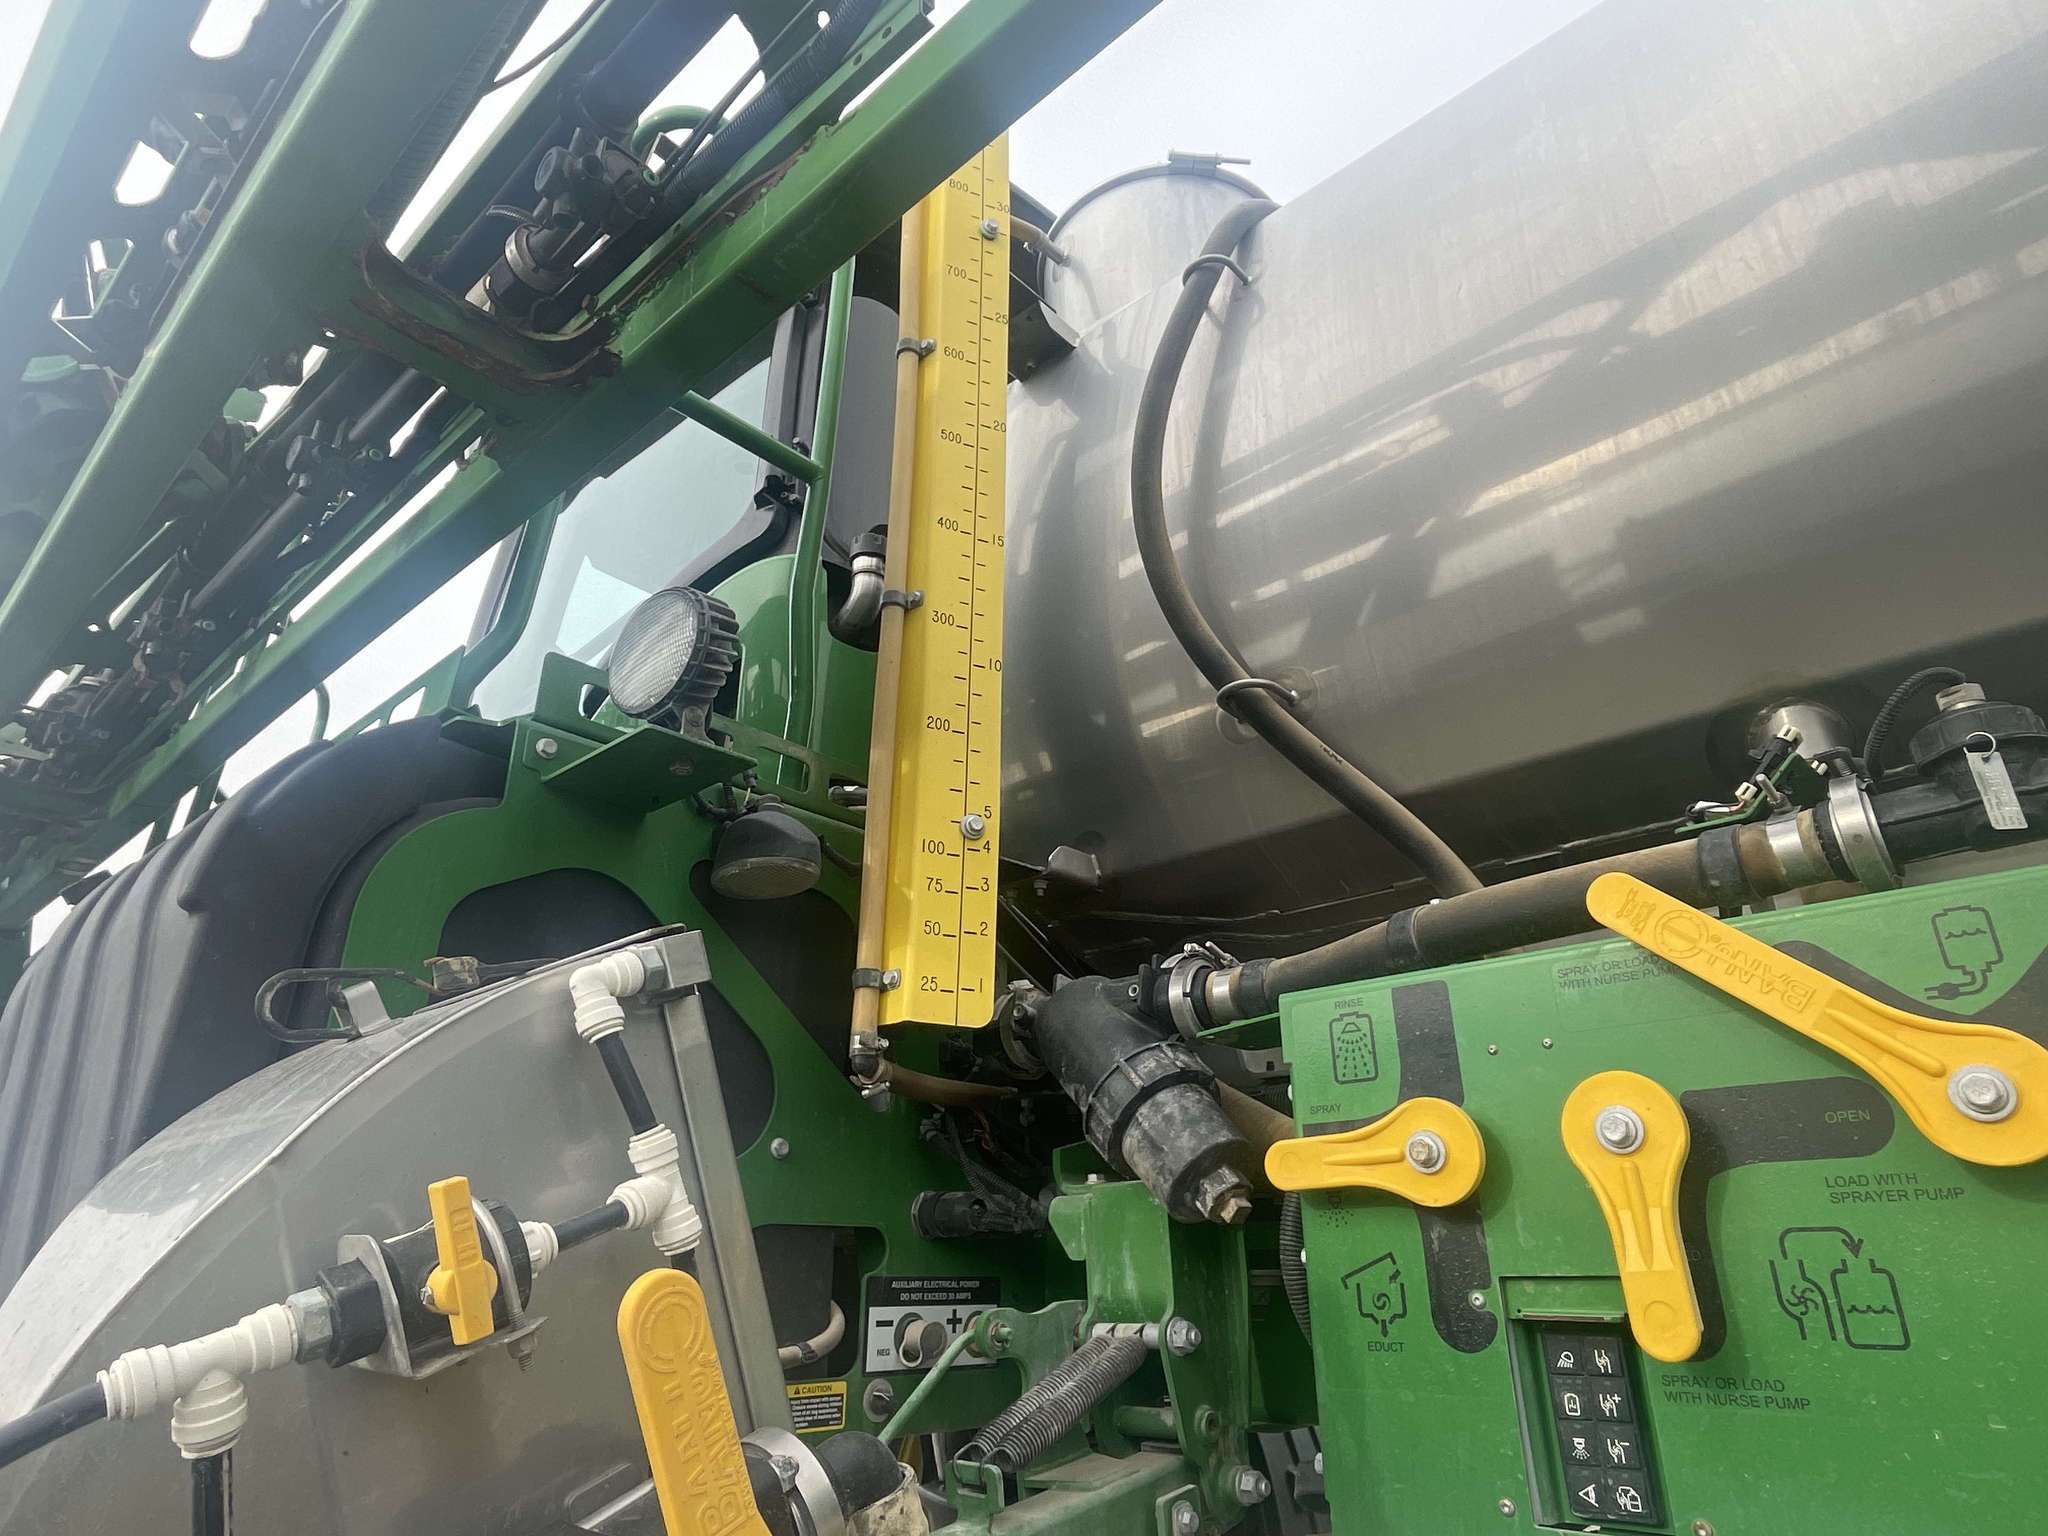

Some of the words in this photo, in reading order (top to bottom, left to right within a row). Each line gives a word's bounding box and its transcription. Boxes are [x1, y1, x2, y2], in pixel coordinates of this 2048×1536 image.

[948, 178, 969, 193] 800
[996, 201, 1010, 214] 30
[946, 263, 967, 279] 700
[995, 312, 1008, 325] 25
[943, 345, 965, 361] 600
[993, 420, 1007, 433] 20
[940, 428, 962, 444] 500
[936, 516, 959, 532] 400
[992, 533, 1005, 547] 15
[932, 610, 955, 627] 300
[989, 657, 1002, 672] 10
[926, 715, 950, 732] 200
[983, 805, 992, 819] 5
[921, 838, 945, 855] 100
[983, 840, 991, 854] 4
[926, 876, 943, 893] 75
[981, 877, 990, 892] 3
[923, 920, 941, 936] 50
[979, 921, 989, 937] 2
[1557, 964, 1598, 979] SPRAY
[1602, 960, 1621, 972] OR
[1624, 954, 1660, 969] LOAD
[920, 975, 938, 992] 25
[1560, 978, 1592, 991] WITH
[1595, 970, 1640, 986] NURSE
[1334, 997, 1364, 1010] RINSE
[1309, 1103, 1342, 1115] SPRAY
[1824, 1109, 1871, 1124] OPEN
[1824, 1174, 1870, 1188] LOAD
[1873, 1172, 1919, 1186] WITH
[1829, 1189, 1910, 1204] SPRAYER
[1913, 1187, 1965, 1201] PUMP
[891, 1280, 923, 1288] AUXILIARY
[923, 1280, 959, 1288] ELECTRICAL
[960, 1280, 980, 1288] POWER
[900, 1292, 910, 1300] DO
[910, 1292, 923, 1300] NOT
[923, 1292, 947, 1300] EXCEED
[876, 1348, 891, 1357] NEG
[1367, 1341, 1405, 1352] EDUCT
[801, 1384, 833, 1395] CAUTION
[1661, 1374, 1710, 1389] SPRAY
[1714, 1377, 1739, 1390] OR
[1742, 1379, 1785, 1392] LOAD
[1664, 1391, 1702, 1404] WITH
[1706, 1393, 1761, 1408] NURSE
[1763, 1395, 1811, 1410] PUMP
